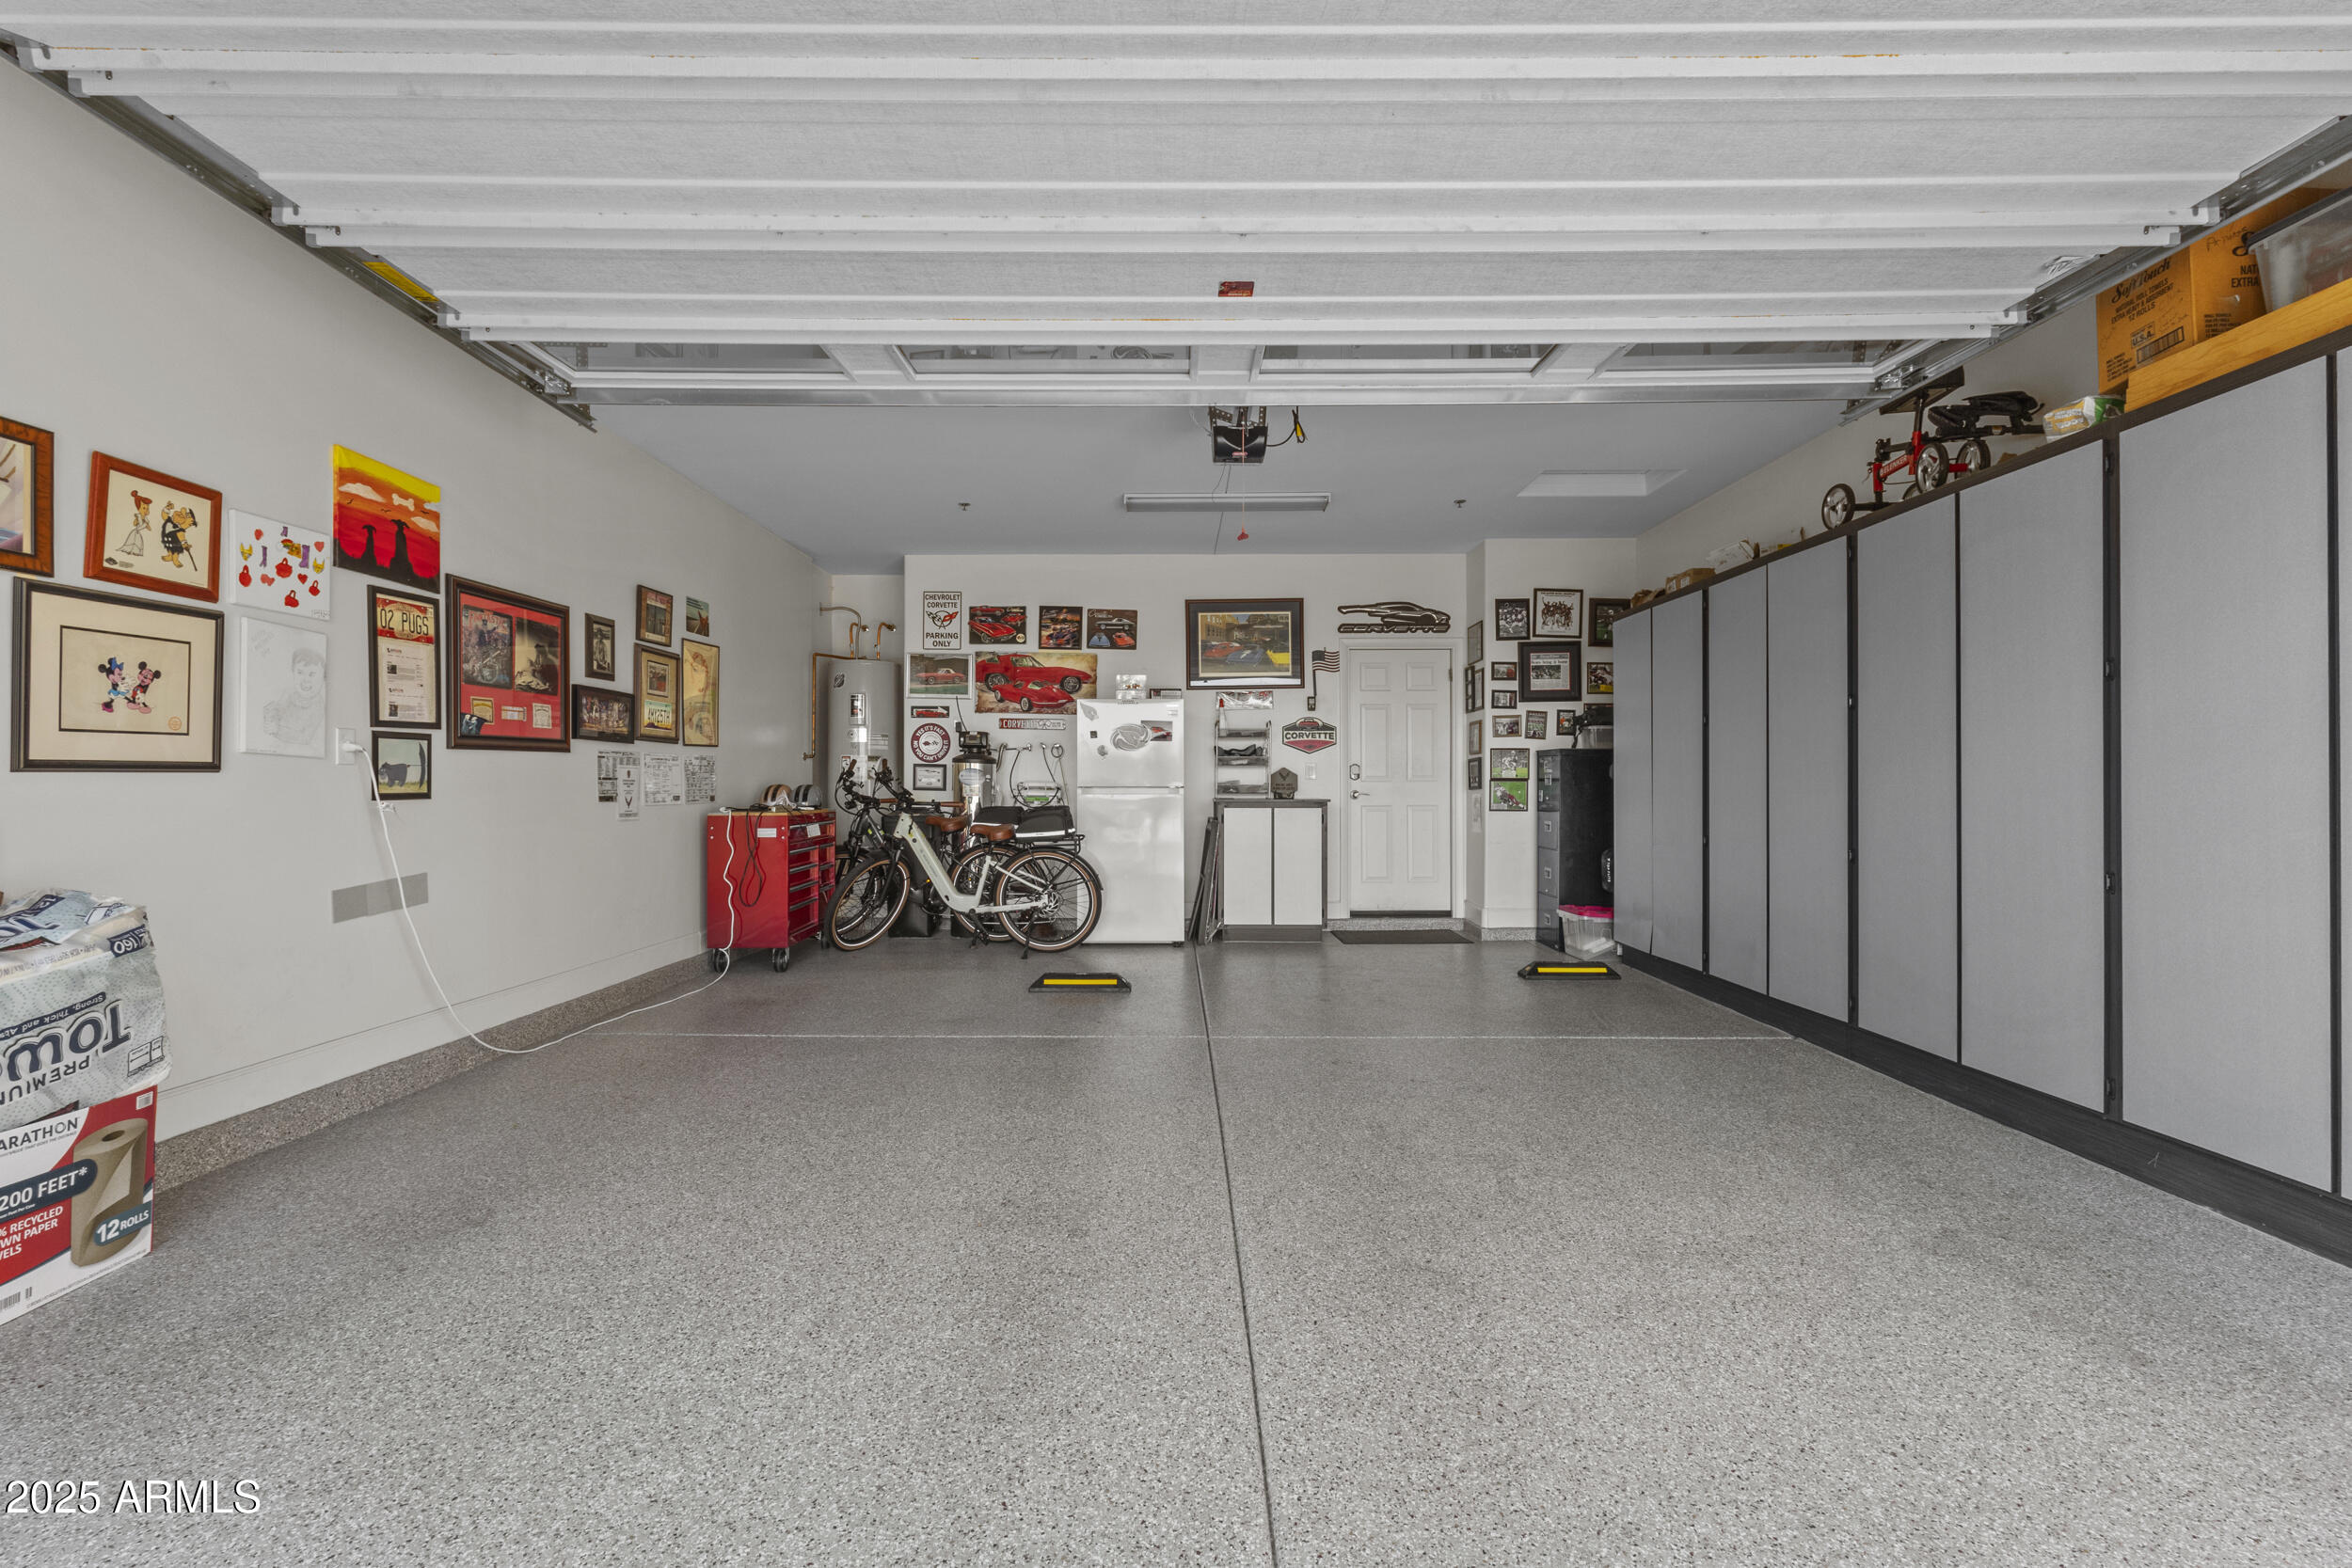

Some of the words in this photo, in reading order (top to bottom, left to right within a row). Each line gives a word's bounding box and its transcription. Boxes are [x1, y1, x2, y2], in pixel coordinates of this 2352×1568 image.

[2240, 264, 2258, 275] NAT
[2231, 277, 2260, 288] EXTRA
[402, 612, 429, 636] PUGS
[1338, 624, 1450, 633] CORVETTE
[113, 933, 138, 955] 160
[72, 994, 103, 1011] Strong,
[22, 1019, 40, 1030] and
[43, 1009, 69, 1022] Thick
[0, 1006, 132, 1082] TOW
[9, 1206, 64, 1233] RECYCLED
[24, 1218, 58, 1240] PAPER
[97, 1218, 120, 1243] 12
[119, 1210, 150, 1230] ROLLS
